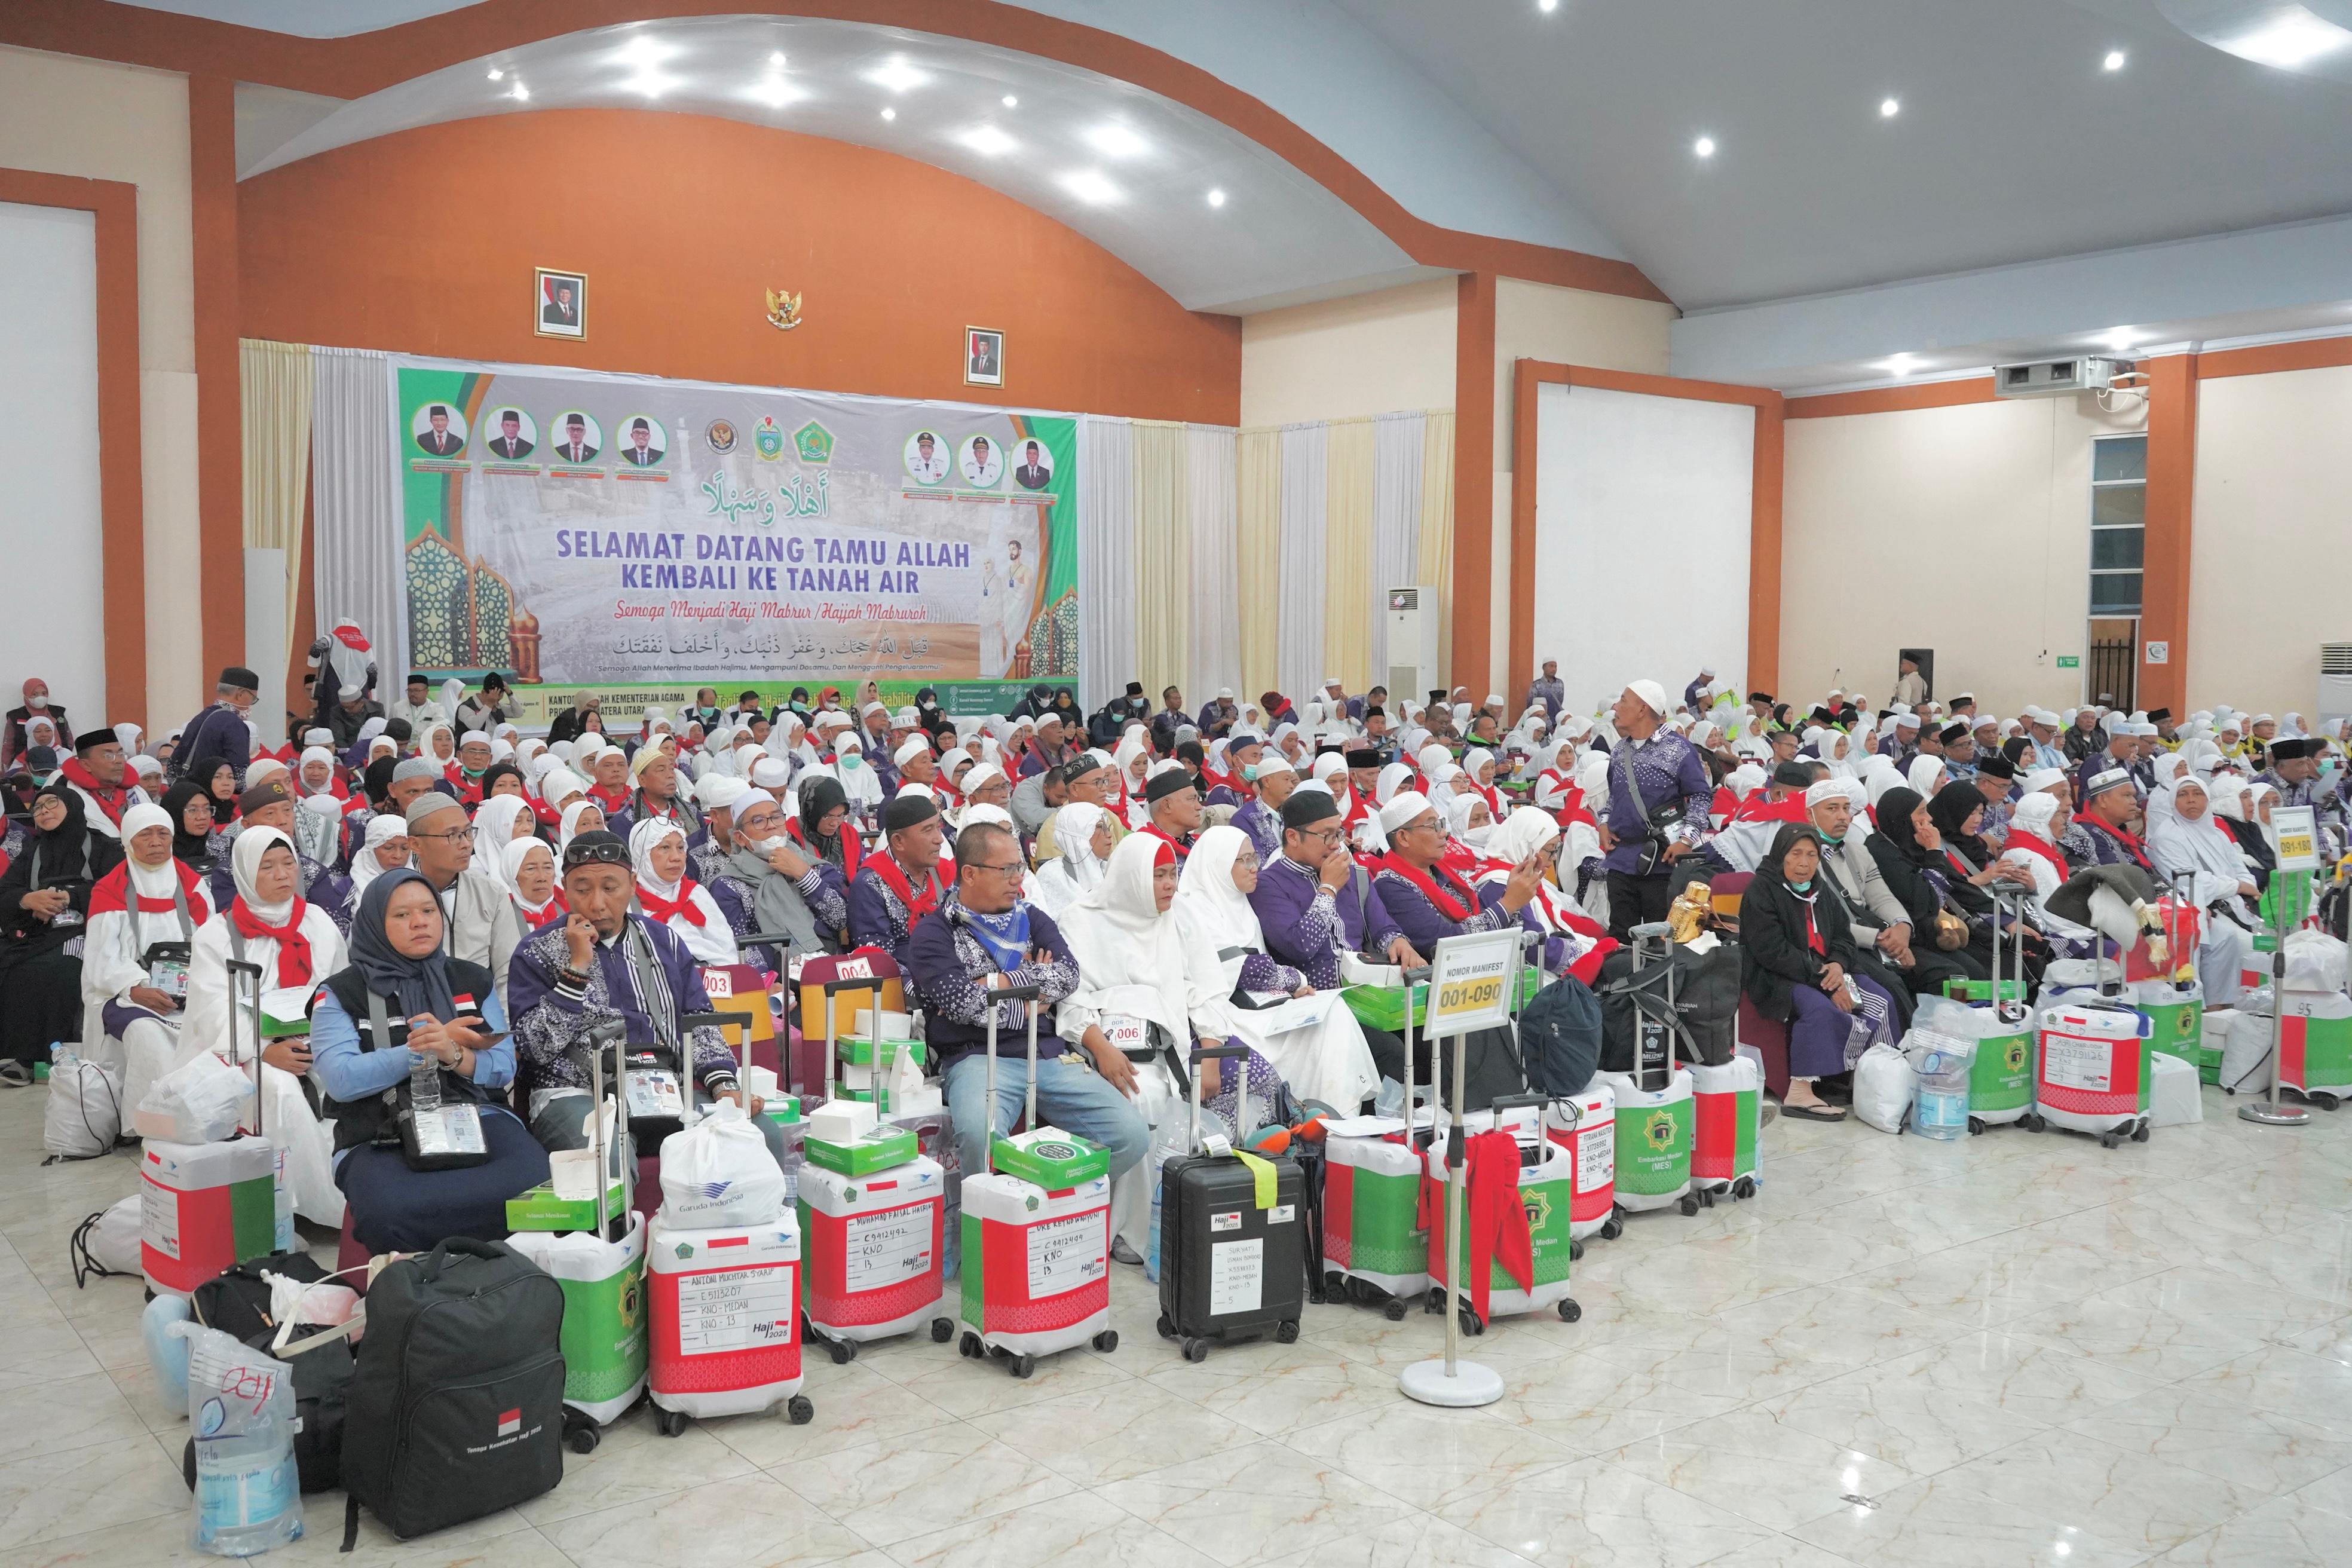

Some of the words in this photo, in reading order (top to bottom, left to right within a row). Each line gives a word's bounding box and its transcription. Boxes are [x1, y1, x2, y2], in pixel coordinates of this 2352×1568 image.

[557, 529, 685, 559] SELAMAT
[696, 534, 804, 563] DATANG
[814, 538, 886, 565] TAMU
[896, 541, 969, 568] ALLAH
[622, 564, 736, 590] KEMBALI
[748, 566, 777, 590] KE
[787, 568, 869, 593] TANAH
[879, 570, 919, 593] AIR
[614, 600, 665, 622] Semoga
[670, 600, 725, 622] Menjadi
[728, 601, 755, 623] Haji
[761, 602, 811, 619] Mabrur
[866, 603, 927, 620] Mabruroh
[721, 664, 748, 672] Hajimu,
[612, 694, 660, 703] KEMENTERIAN
[661, 693, 685, 702] AGAMA
[841, 963, 868, 981] 004
[1447, 966, 1470, 977] NOMOR
[1471, 961, 1503, 974] MANIFEST
[704, 976, 727, 993] 003
[1440, 983, 1502, 1008] 001-090
[2298, 1003, 2313, 1016] 95
[1117, 1028, 1139, 1039] 006
[1652, 1160, 1672, 1172] (MES)
[679, 1203, 708, 1212] Garuda
[710, 1193, 743, 1207] Indonesia
[856, 1213, 887, 1226] MUHAMAD
[889, 1209, 911, 1220] FAISAL
[1215, 1215, 1229, 1229] Haji
[1536, 1238, 1558, 1246] Medan
[863, 1244, 883, 1256] KNO
[1044, 1250, 1062, 1263] KNO
[902, 1254, 918, 1271] Haji
[914, 1261, 929, 1270] 2025
[1081, 1260, 1095, 1276] Haji
[691, 1275, 717, 1285] ANTONI
[719, 1271, 749, 1282] MUCHTAR
[751, 1267, 774, 1277] SYARIF
[1044, 1266, 1052, 1275] 13
[1092, 1266, 1104, 1275] 2025
[701, 1292, 706, 1300] E
[708, 1287, 741, 1300] 5113207
[701, 1304, 717, 1315] KNO
[724, 1300, 748, 1313] MEDAN
[700, 1319, 717, 1330] KNO
[727, 1315, 736, 1325] 13
[753, 1321, 774, 1339] Haji
[768, 1330, 788, 1339] 2025
[467, 1446, 488, 1454] Tenaga
[489, 1436, 517, 1450] Kesehatan
[519, 1431, 529, 1441] Haji
